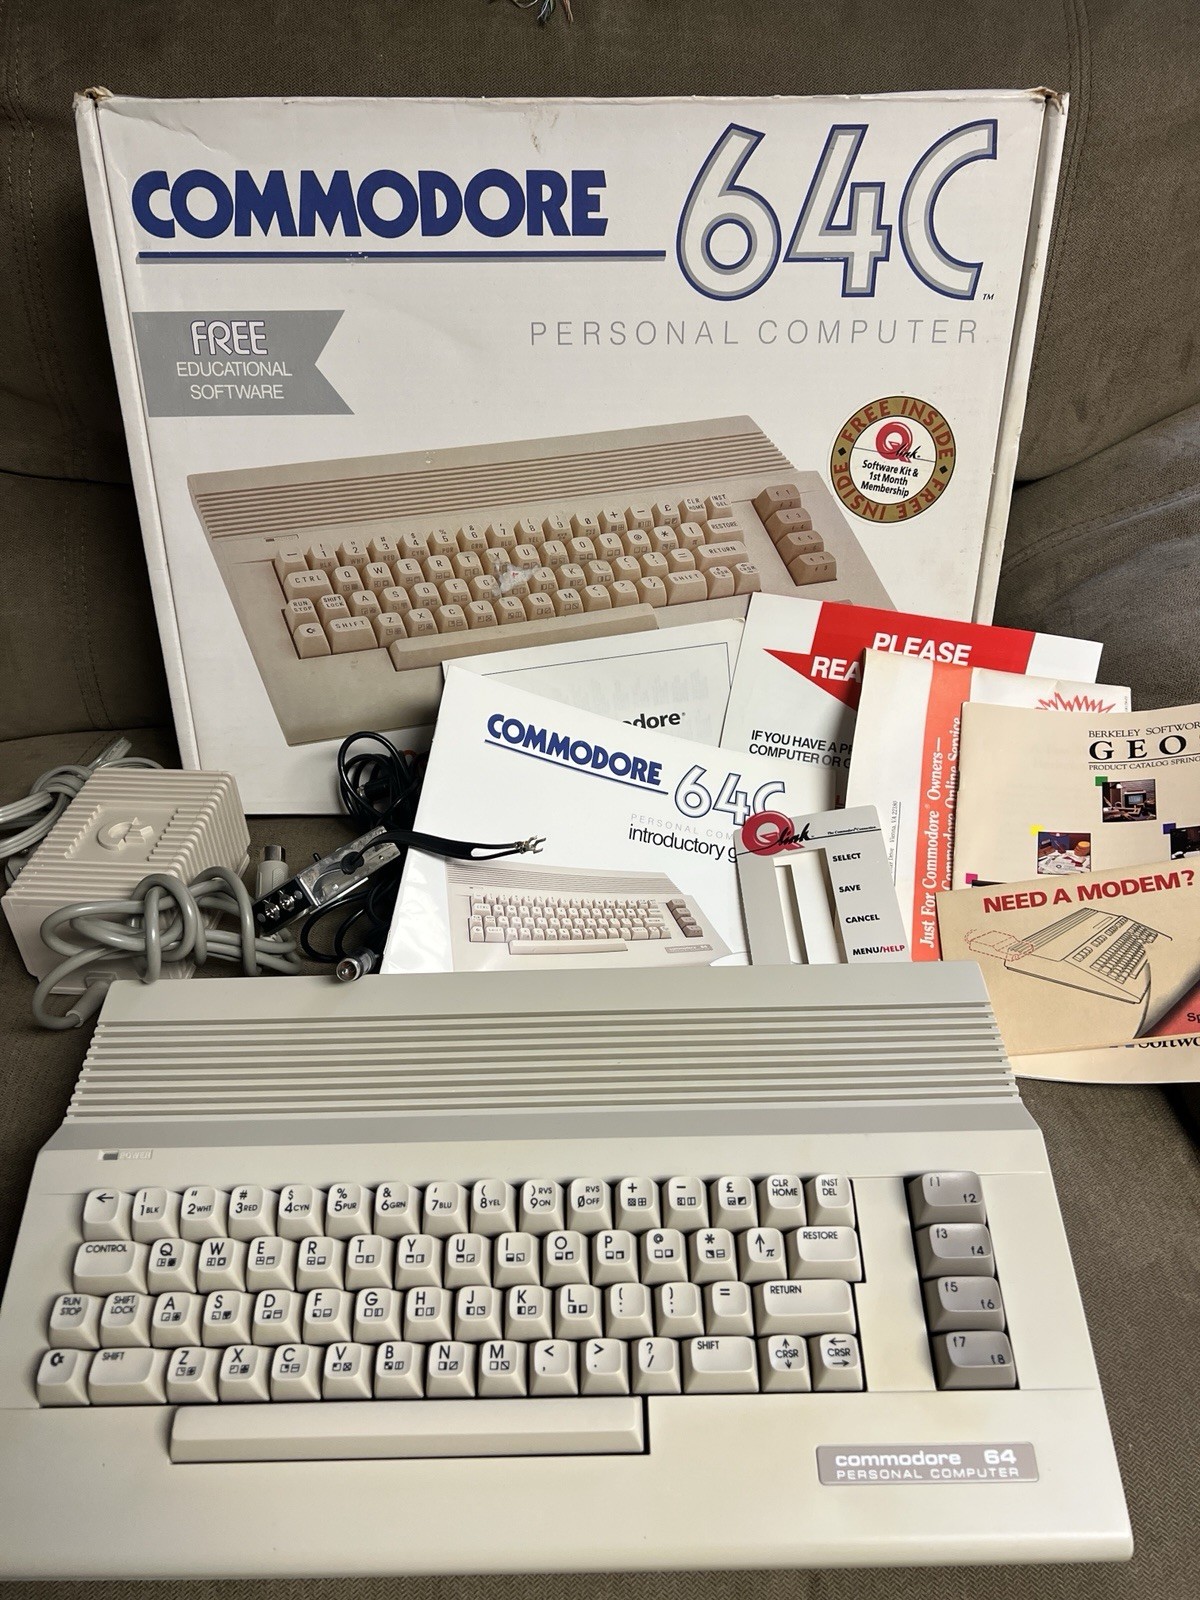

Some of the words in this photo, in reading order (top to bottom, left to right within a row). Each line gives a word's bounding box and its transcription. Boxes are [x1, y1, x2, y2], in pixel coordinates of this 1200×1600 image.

[131, 168, 608, 238] COMMODORE
[676, 119, 997, 301] 64C
[190, 320, 268, 356] FREE
[531, 320, 739, 346] PERSONAL
[759, 319, 977, 344] COMPUTER
[176, 361, 293, 377] EDUCATIONAL
[190, 384, 285, 400] SOFTWARE
[841, 400, 891, 444] FREE
[900, 399, 954, 460] INSIDE
[862, 460, 899, 474] Software
[900, 466, 912, 476] Kit
[912, 468, 919, 477] &
[869, 472, 881, 481] 1st
[882, 474, 908, 486] Month
[834, 461, 886, 520] INSIDE
[860, 481, 910, 498] Membership
[896, 478, 944, 520] FREE
[295, 575, 322, 584] CTRL
[335, 620, 365, 629] SHIFT
[872, 632, 972, 666] PLEASE
[811, 656, 862, 683] REA
[1088, 729, 1141, 738] BERKELEY
[1146, 721, 1200, 736] SOFTWOR
[751, 730, 763, 740] IF
[764, 731, 791, 745] YOU
[792, 736, 827, 751] HAVE
[828, 742, 837, 753] A
[948, 717, 961, 761] Service
[487, 713, 663, 786] COMMODORE
[749, 743, 820, 764] COMPUTER
[822, 755, 841, 767] OR
[1129, 760, 1169, 770] CATALOG
[631, 813, 699, 835] PERSONAL
[629, 824, 726, 860] introductory
[922, 810, 940, 889] Commodore
[832, 852, 861, 862] SELECT
[839, 884, 861, 893] SAVE
[983, 891, 1047, 914] NEED
[1053, 888, 1072, 905] A
[1076, 870, 1196, 902] MODEM?
[921, 892, 935, 917] For
[845, 913, 880, 924] CANCEL
[920, 920, 935, 948] Just
[852, 944, 906, 956] MENU/HELP
[726, 1182, 734, 1193] £
[772, 1179, 789, 1187] CLR
[822, 1178, 838, 1186] INST
[383, 1188, 392, 1198] &
[772, 1187, 798, 1197] HOME
[822, 1187, 837, 1195] DEL
[530, 1197, 538, 1209] 9
[586, 1197, 600, 1205] OFF
[605, 1236, 613, 1248] P
[803, 1231, 838, 1240] RESTORE
[85, 1244, 127, 1253] CONTROL
[160, 1242, 173, 1256] Q
[209, 1242, 224, 1255] W
[257, 1242, 265, 1255] E
[308, 1241, 317, 1254] R
[357, 1240, 364, 1253] T
[407, 1239, 416, 1252] Y
[456, 1238, 465, 1252] U
[505, 1238, 509, 1251] I
[555, 1237, 568, 1250] O
[567, 1289, 575, 1302] L
[770, 1285, 802, 1294] RETURN
[62, 1297, 80, 1306] RUN
[113, 1295, 136, 1304] SHIFT
[214, 1295, 223, 1308] S
[264, 1294, 276, 1308] D
[314, 1293, 322, 1306] F
[365, 1292, 378, 1305] G
[416, 1292, 425, 1305] H
[467, 1290, 475, 1304] J
[517, 1290, 527, 1303] K
[111, 1305, 135, 1314] LOCK
[164, 1297, 175, 1310] A
[60, 1306, 81, 1315] STOP
[439, 1345, 450, 1358] N
[490, 1345, 504, 1358] M
[697, 1341, 719, 1349] SHIFT
[102, 1352, 124, 1361] SHIFT
[179, 1351, 189, 1364] Z
[232, 1349, 244, 1362] X
[283, 1348, 296, 1361] C
[335, 1346, 347, 1360] V
[385, 1346, 394, 1359] B
[775, 1350, 798, 1358] CRSR
[827, 1348, 850, 1357] CRSR
[835, 1452, 961, 1466] commodore
[984, 1449, 1017, 1464] 64
[837, 1469, 923, 1479] PERSONAL
[930, 1467, 1019, 1478] COMPUTER
